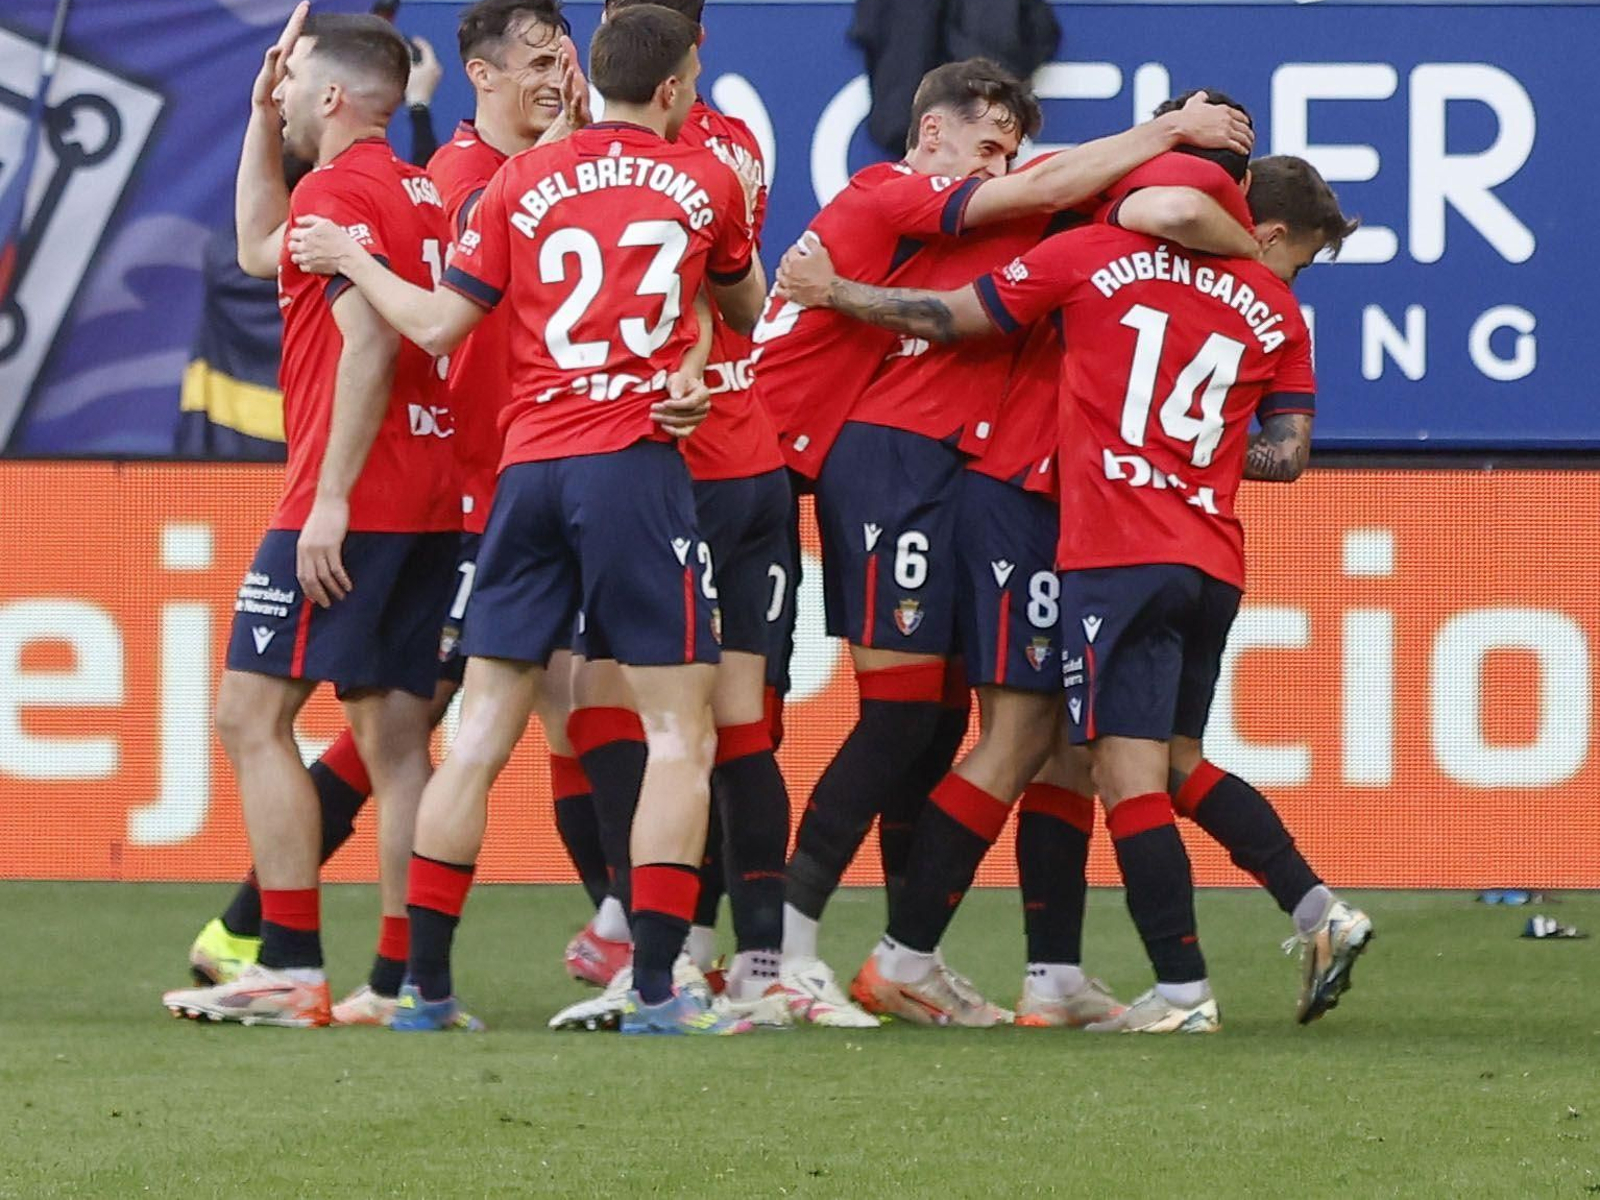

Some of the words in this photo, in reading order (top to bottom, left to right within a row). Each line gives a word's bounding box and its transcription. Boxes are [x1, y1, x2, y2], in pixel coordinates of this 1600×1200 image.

[510, 171, 578, 240] ABEL
[575, 156, 714, 231] BRETONES
[538, 219, 690, 370] 23
[1090, 245, 1191, 299] RUBÉN
[1194, 266, 1286, 354] GARCÍA
[1118, 303, 1247, 468] 14
[894, 530, 930, 589] 6
[1026, 570, 1061, 629] 8
